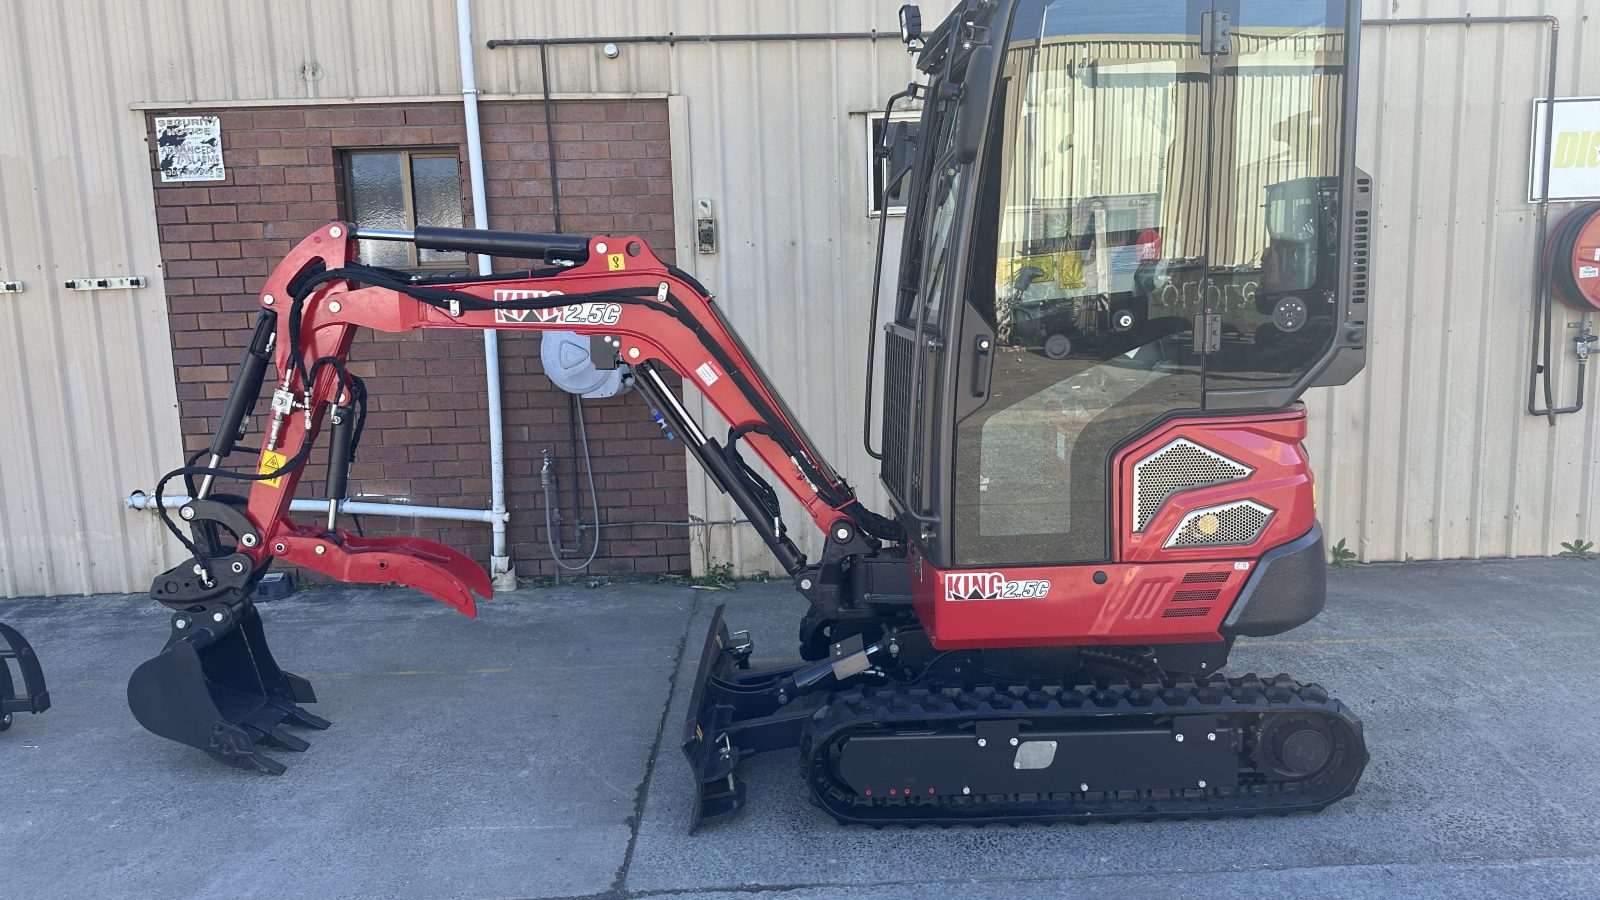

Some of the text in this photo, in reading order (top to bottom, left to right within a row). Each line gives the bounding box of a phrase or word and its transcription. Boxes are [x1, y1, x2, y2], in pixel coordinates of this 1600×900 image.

[157, 118, 217, 127] SECURITY
[166, 127, 211, 136] NOTICE
[565, 303, 622, 325] 2.5C
[945, 573, 1050, 601] KING 2.5C
